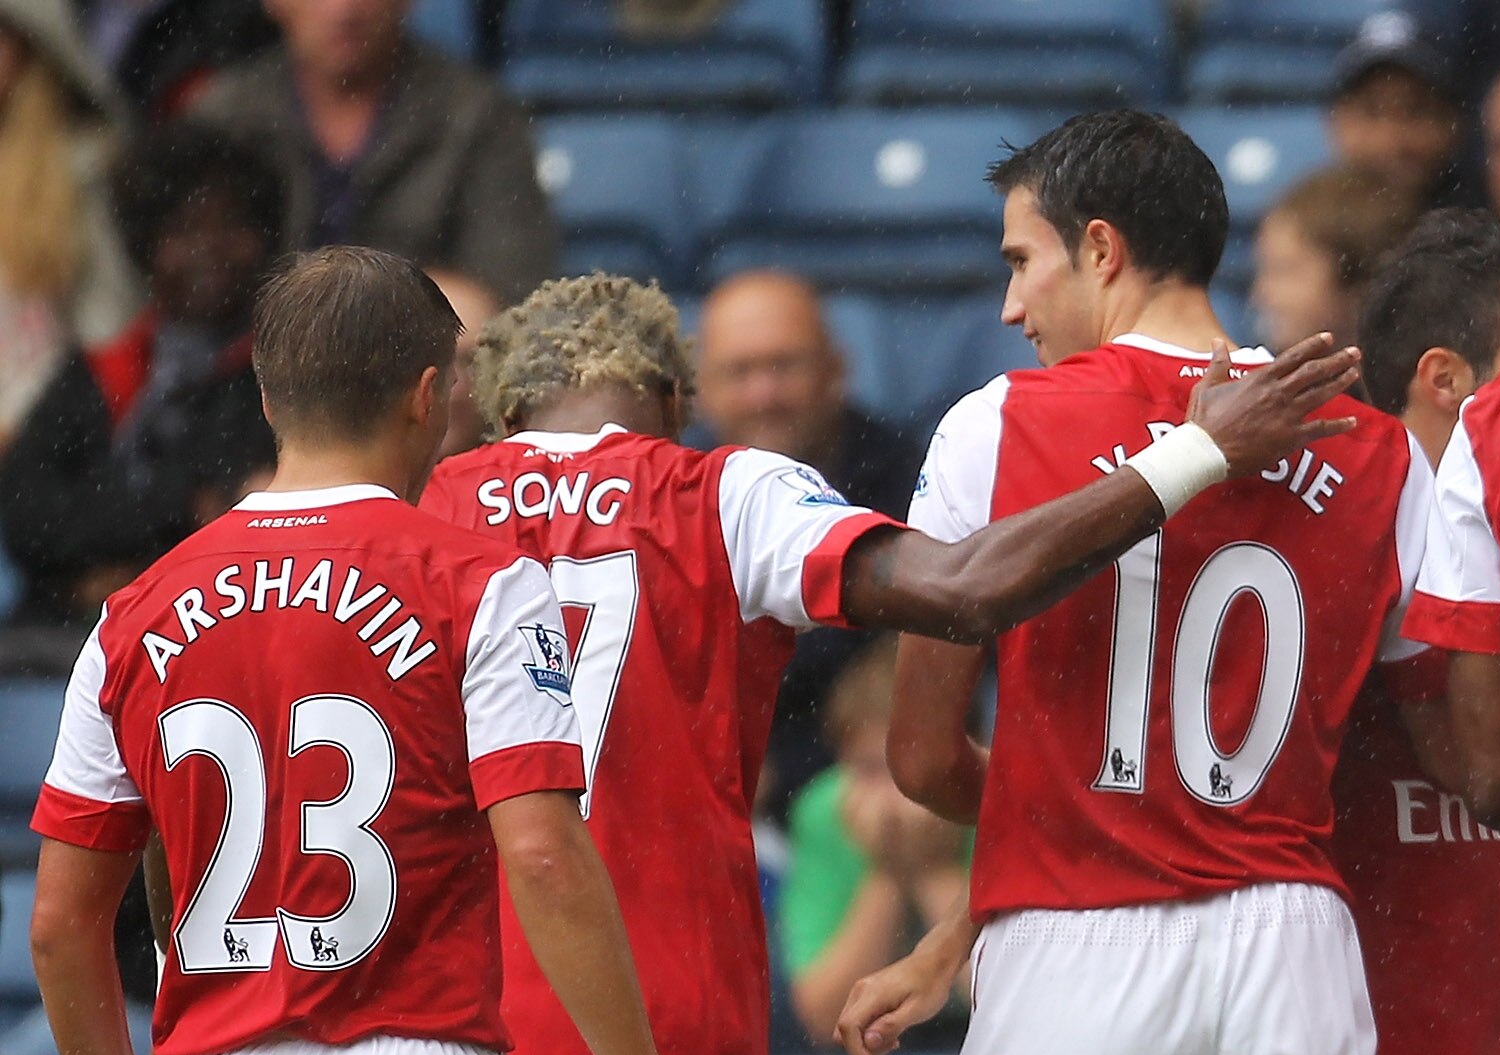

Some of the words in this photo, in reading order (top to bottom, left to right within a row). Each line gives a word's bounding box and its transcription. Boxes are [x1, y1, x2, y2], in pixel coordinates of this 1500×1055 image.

[246, 514, 329, 529] ARSENAL
[476, 471, 633, 526] SONG
[139, 556, 437, 684] ARSHAVIN
[549, 550, 640, 821] 7
[1090, 526, 1306, 808] 10
[157, 693, 398, 973] 23
